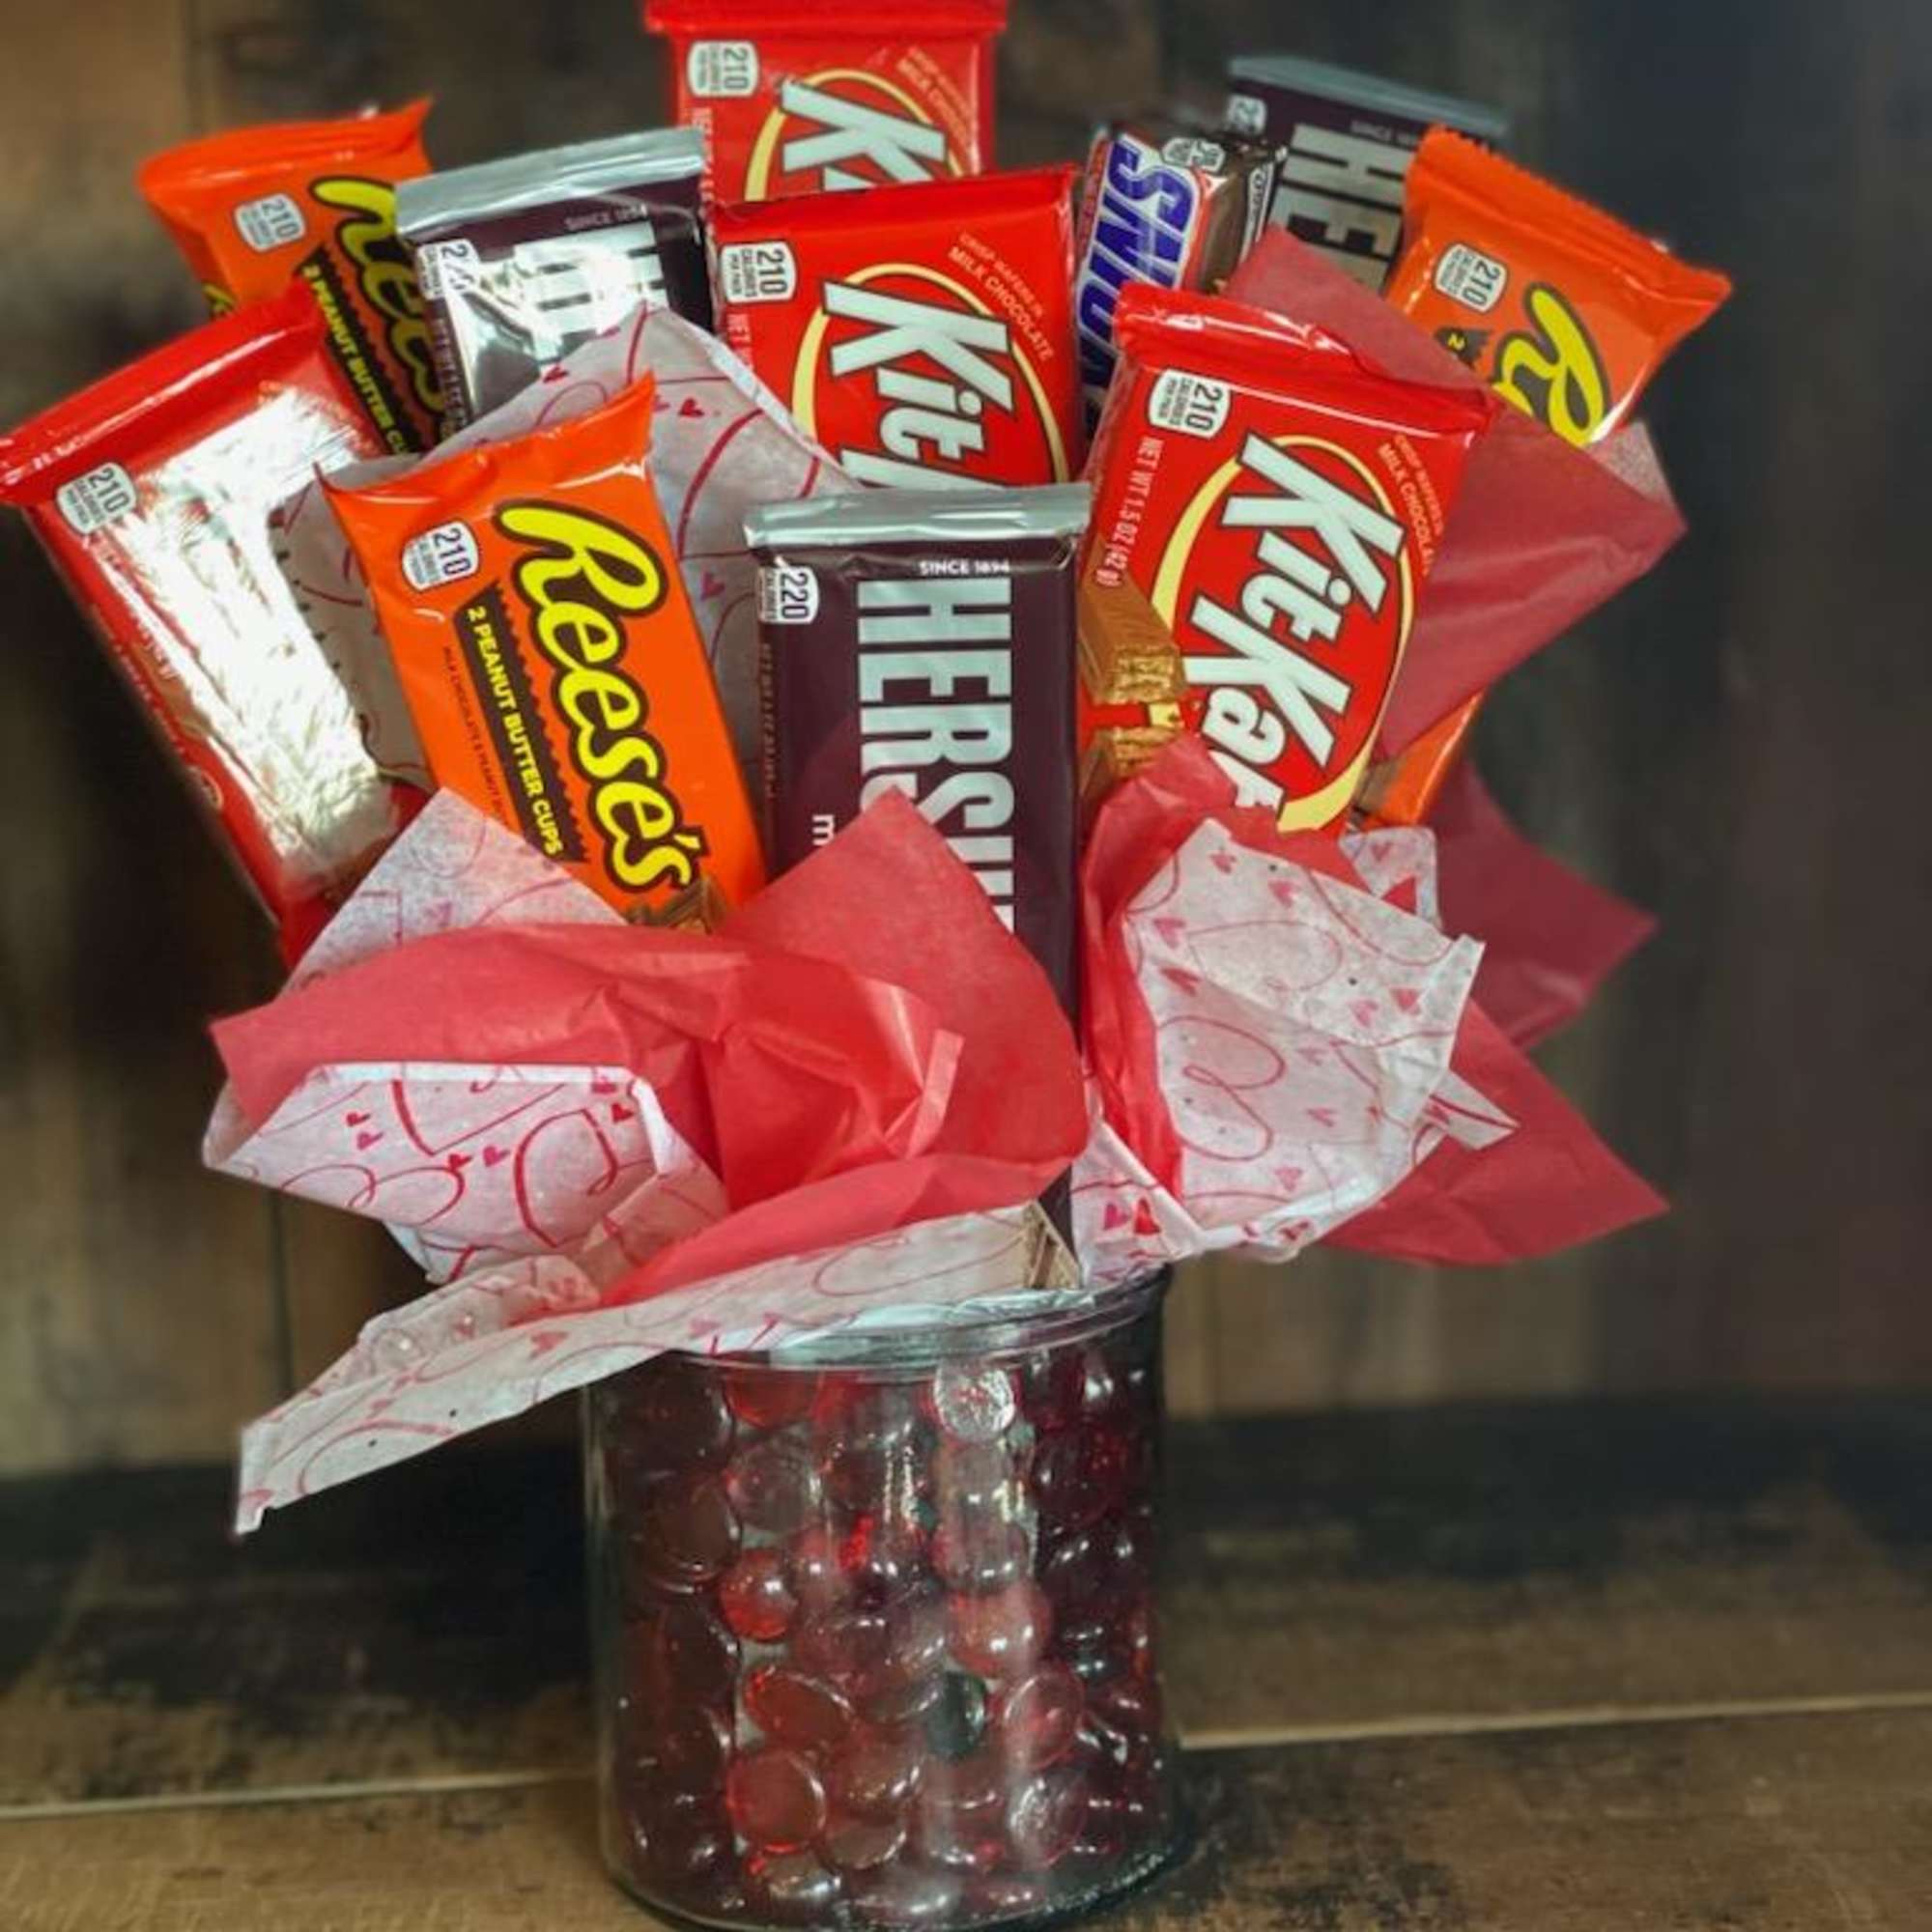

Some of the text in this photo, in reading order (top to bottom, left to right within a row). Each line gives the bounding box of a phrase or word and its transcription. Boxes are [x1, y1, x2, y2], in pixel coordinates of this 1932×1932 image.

[724, 47, 750, 90] 210
[260, 198, 300, 240] 210
[756, 248, 788, 295] 210
[1462, 259, 1501, 306] 210
[948, 246, 1054, 361] MILK CHOCOLATE
[349, 356, 395, 429] BUTTER
[1184, 383, 1223, 431] 210
[1136, 437, 1164, 469] NET
[88, 467, 130, 513] 210
[1128, 470, 1155, 498] WT
[1112, 522, 1139, 545] OZ
[1120, 498, 1145, 522] 1.5
[433, 527, 471, 577] 210
[919, 558, 969, 576] SINCE
[468, 606, 487, 623] 2
[781, 572, 810, 620] 220
[473, 624, 518, 709] PEANUT
[497, 506, 702, 887] Reese's
[503, 713, 544, 798] BUTTER
[532, 799, 564, 855] CUPS
